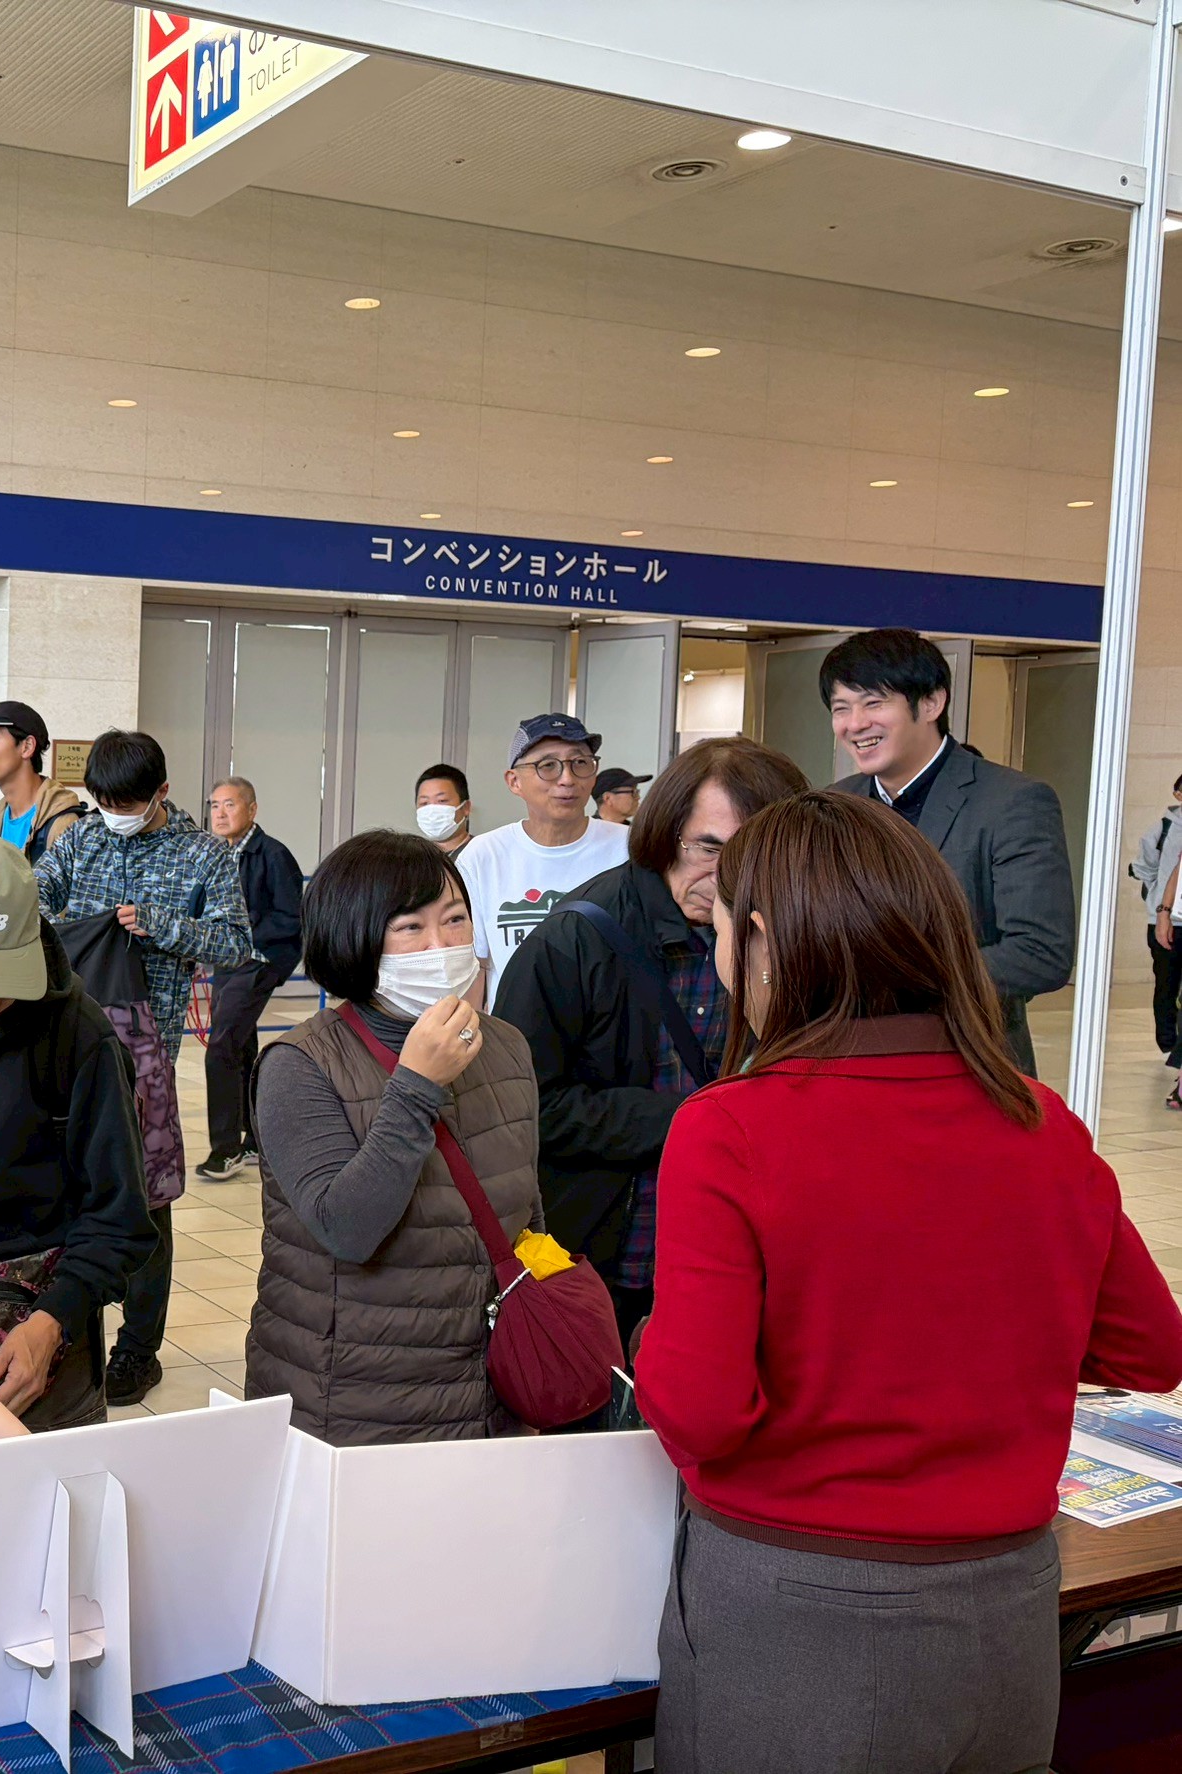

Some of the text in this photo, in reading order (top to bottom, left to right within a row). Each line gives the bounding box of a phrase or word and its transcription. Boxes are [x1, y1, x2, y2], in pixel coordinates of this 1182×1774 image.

[248, 42, 301, 96] TOILET
[369, 535, 668, 584] コンベンションホール
[425, 575, 618, 604] CONVENTION HALL
